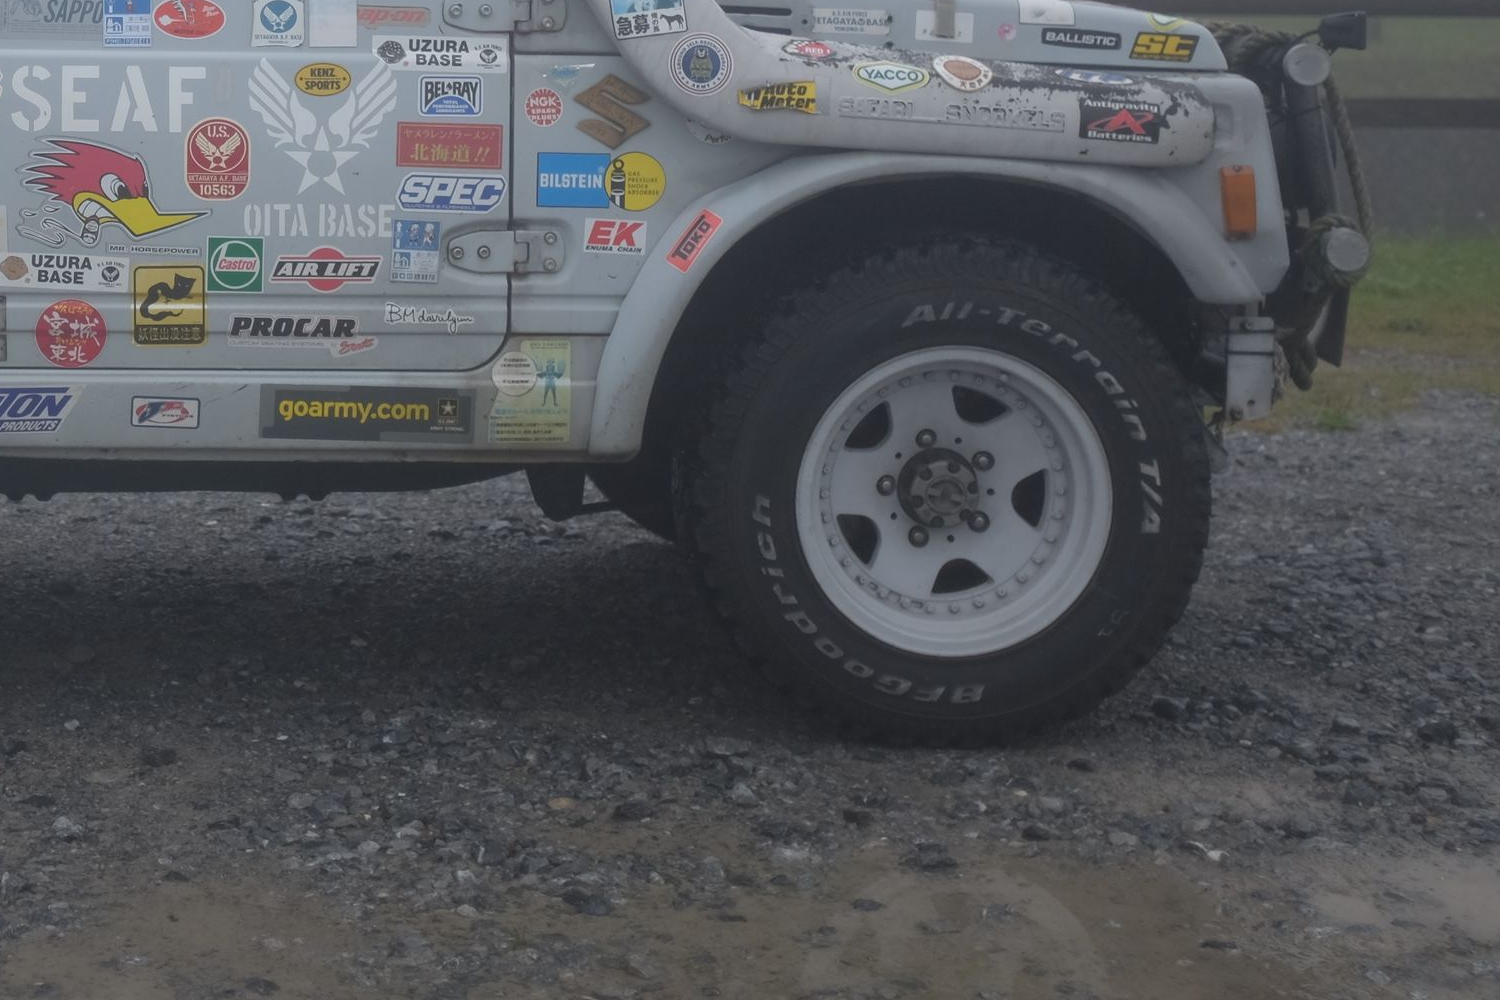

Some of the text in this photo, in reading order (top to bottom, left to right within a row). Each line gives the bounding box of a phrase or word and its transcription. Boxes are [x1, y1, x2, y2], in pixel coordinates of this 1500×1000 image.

[408, 39, 469, 53] UZURA
[1046, 32, 1117, 47] BALLISTIC
[416, 53, 463, 67] BASE
[310, 67, 336, 78] KENZ
[864, 69, 918, 81] YACCO
[304, 79, 341, 91] SPORTS
[11, 65, 207, 133] SEAF
[529, 97, 557, 107] NGK
[1083, 99, 1159, 113] Antigravity
[206, 126, 230, 138] U.S.
[1087, 129, 1152, 143] Batteries
[540, 174, 603, 189] BILSTEIN
[199, 184, 236, 196] 10563
[402, 177, 506, 205] SPEC
[243, 204, 396, 237] OITA BASE
[588, 221, 645, 247] EK
[670, 214, 712, 263] TOKO
[109, 245, 199, 255] MR. HORSEPOWER
[617, 246, 642, 254] CHAIN
[31, 254, 92, 270] UZURA
[218, 257, 257, 272] Castrol
[277, 262, 375, 277] AIR LIFT
[37, 270, 84, 285] BASE
[230, 316, 357, 338] PROCAR
[279, 400, 430, 425] goarmy.com
[900, 301, 1164, 536] All-Terrain T/A
[751, 493, 988, 706] BFGoodrich
